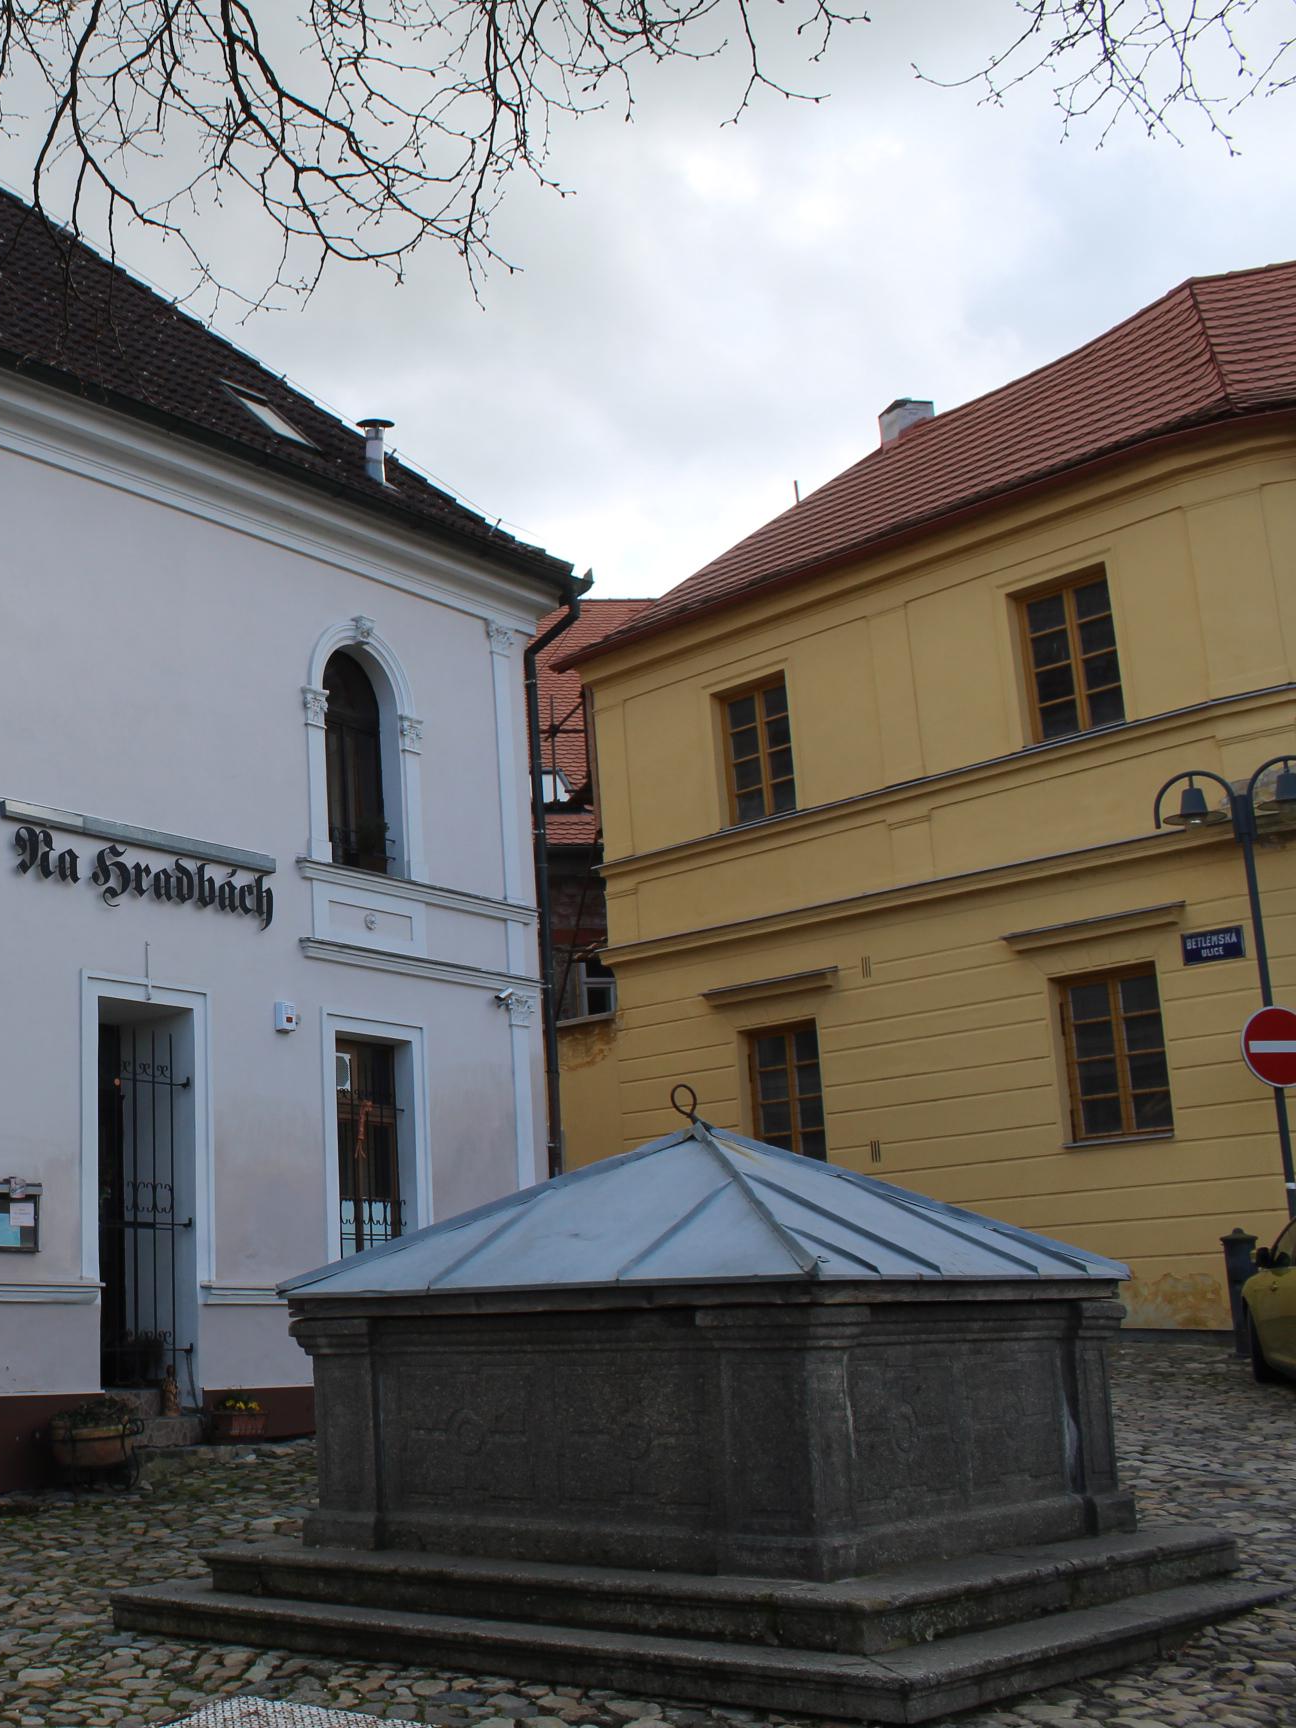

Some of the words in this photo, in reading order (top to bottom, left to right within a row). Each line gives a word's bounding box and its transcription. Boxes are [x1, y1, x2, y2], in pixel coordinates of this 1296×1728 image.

[15, 826, 81, 884] Na
[91, 844, 274, 931] Hradbách
[1186, 929, 1238, 950] BETLÉMSKÁ
[1201, 946, 1224, 957] ULICE
